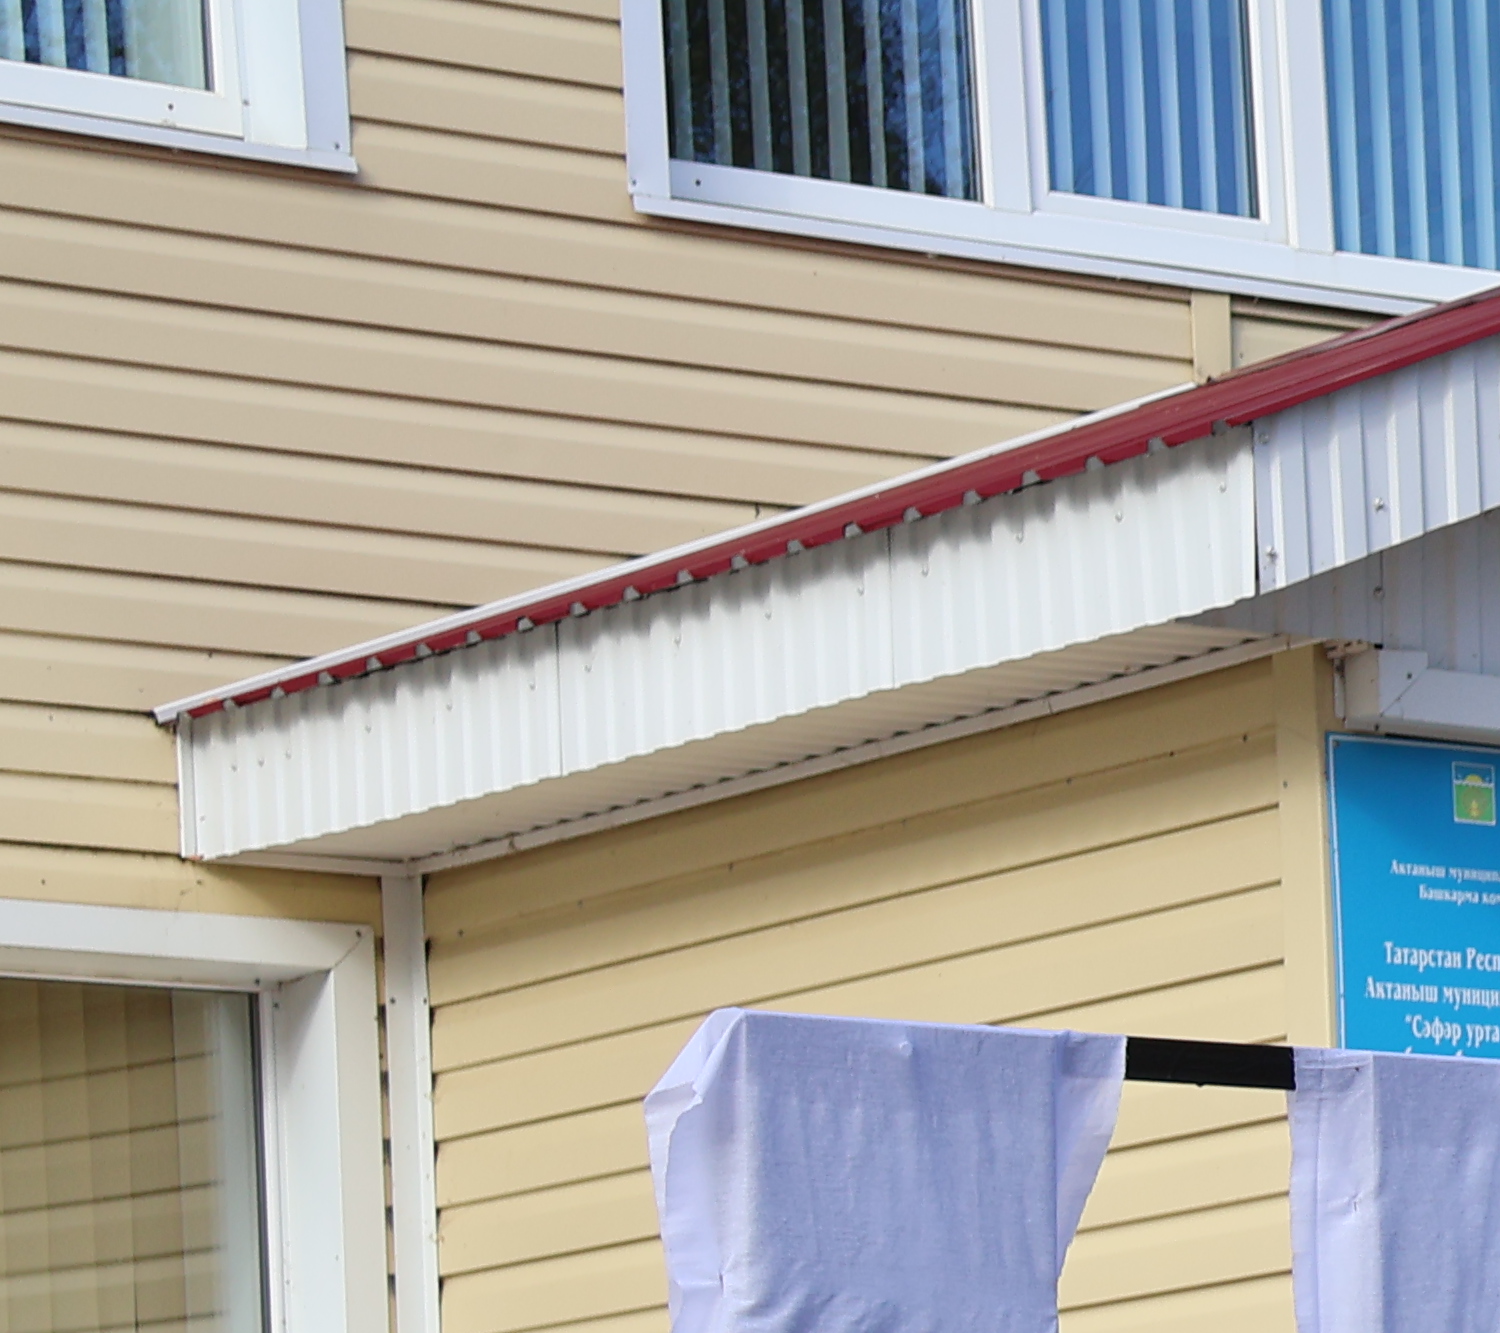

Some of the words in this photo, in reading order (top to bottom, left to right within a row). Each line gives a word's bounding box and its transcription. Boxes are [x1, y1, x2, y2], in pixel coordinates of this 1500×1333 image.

[1390, 859, 1446, 878] Актаныш
[1419, 884, 1479, 906] Башкарма
[1384, 941, 1462, 972] Татарстан
[1365, 976, 1438, 1003] Актаныш
[1466, 1025, 1500, 1048] урта
